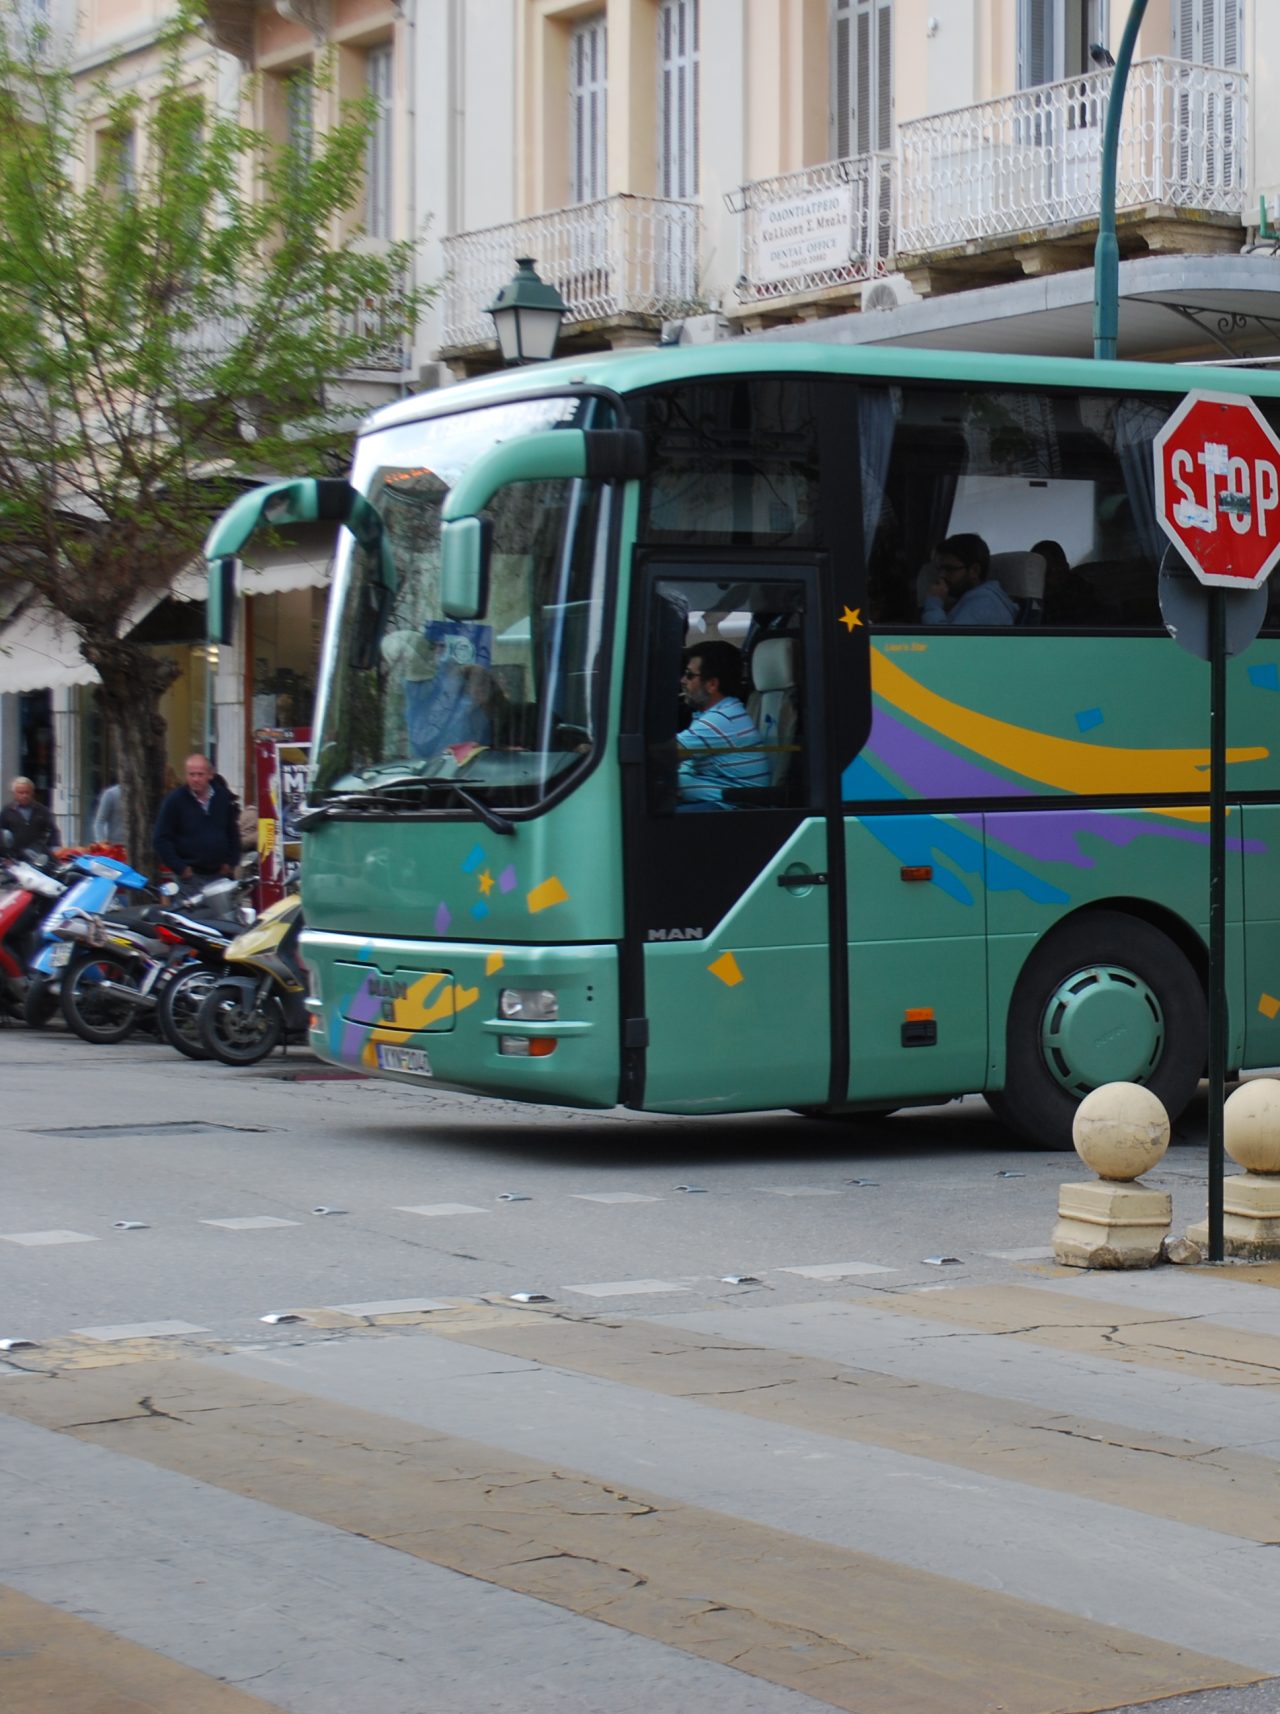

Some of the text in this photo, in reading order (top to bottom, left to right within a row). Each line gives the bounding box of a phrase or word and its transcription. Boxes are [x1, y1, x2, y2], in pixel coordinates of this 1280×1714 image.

[770, 239, 836, 262] DENTAL OFFICE
[1171, 449, 1279, 537] STOP
[648, 927, 703, 940] MAN
[368, 979, 407, 1000] MAN
